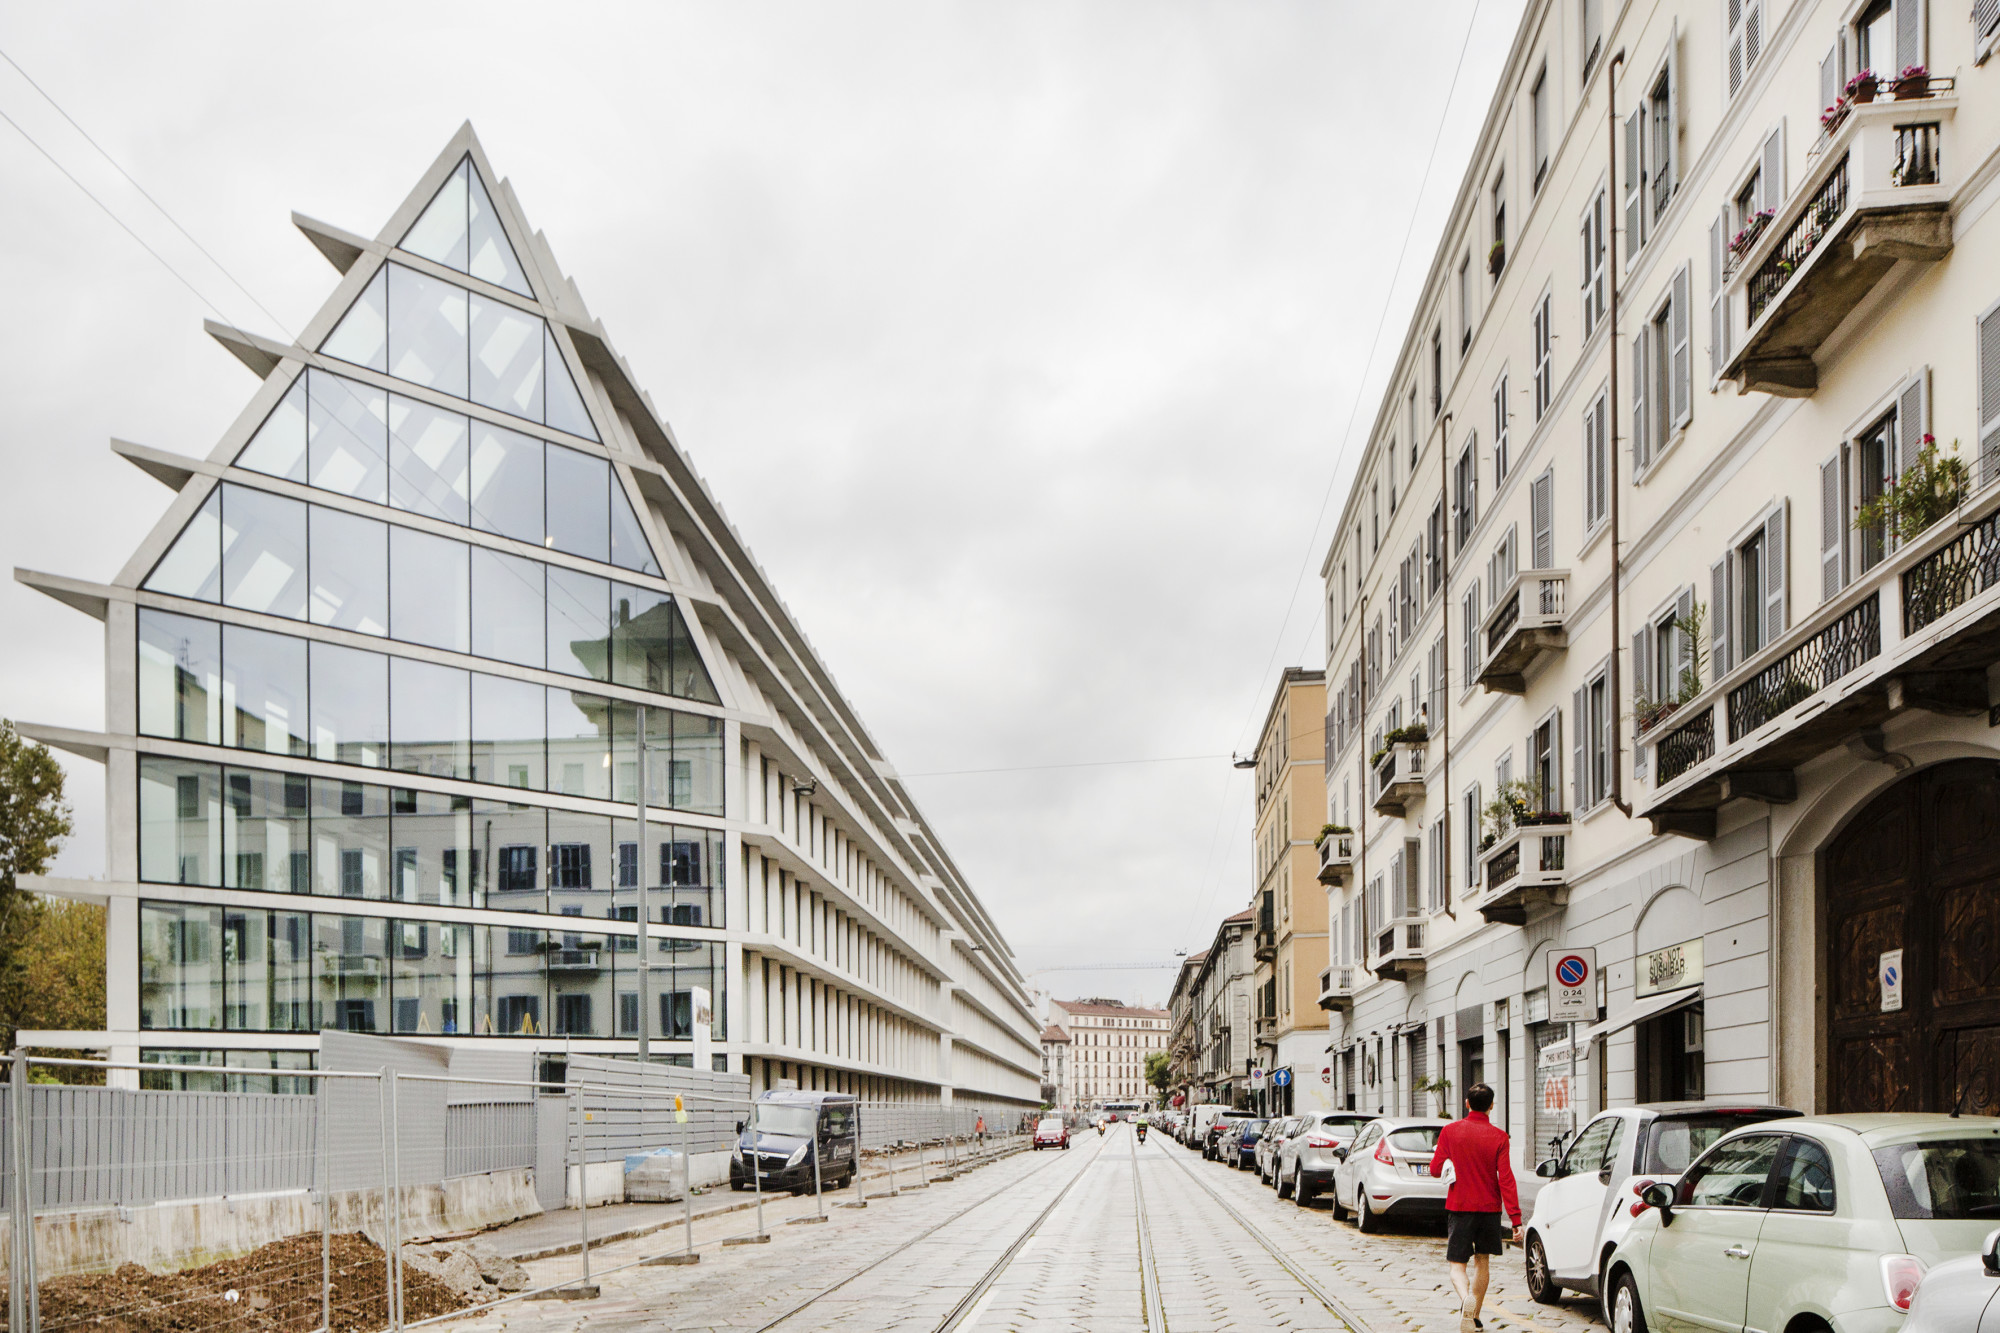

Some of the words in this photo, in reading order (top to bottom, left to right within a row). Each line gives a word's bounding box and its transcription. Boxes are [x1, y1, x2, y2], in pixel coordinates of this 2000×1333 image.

[1649, 952, 1662, 967] THIS
[1668, 947, 1680, 962] NOT
[1649, 958, 1685, 980] SUSHIBAR
